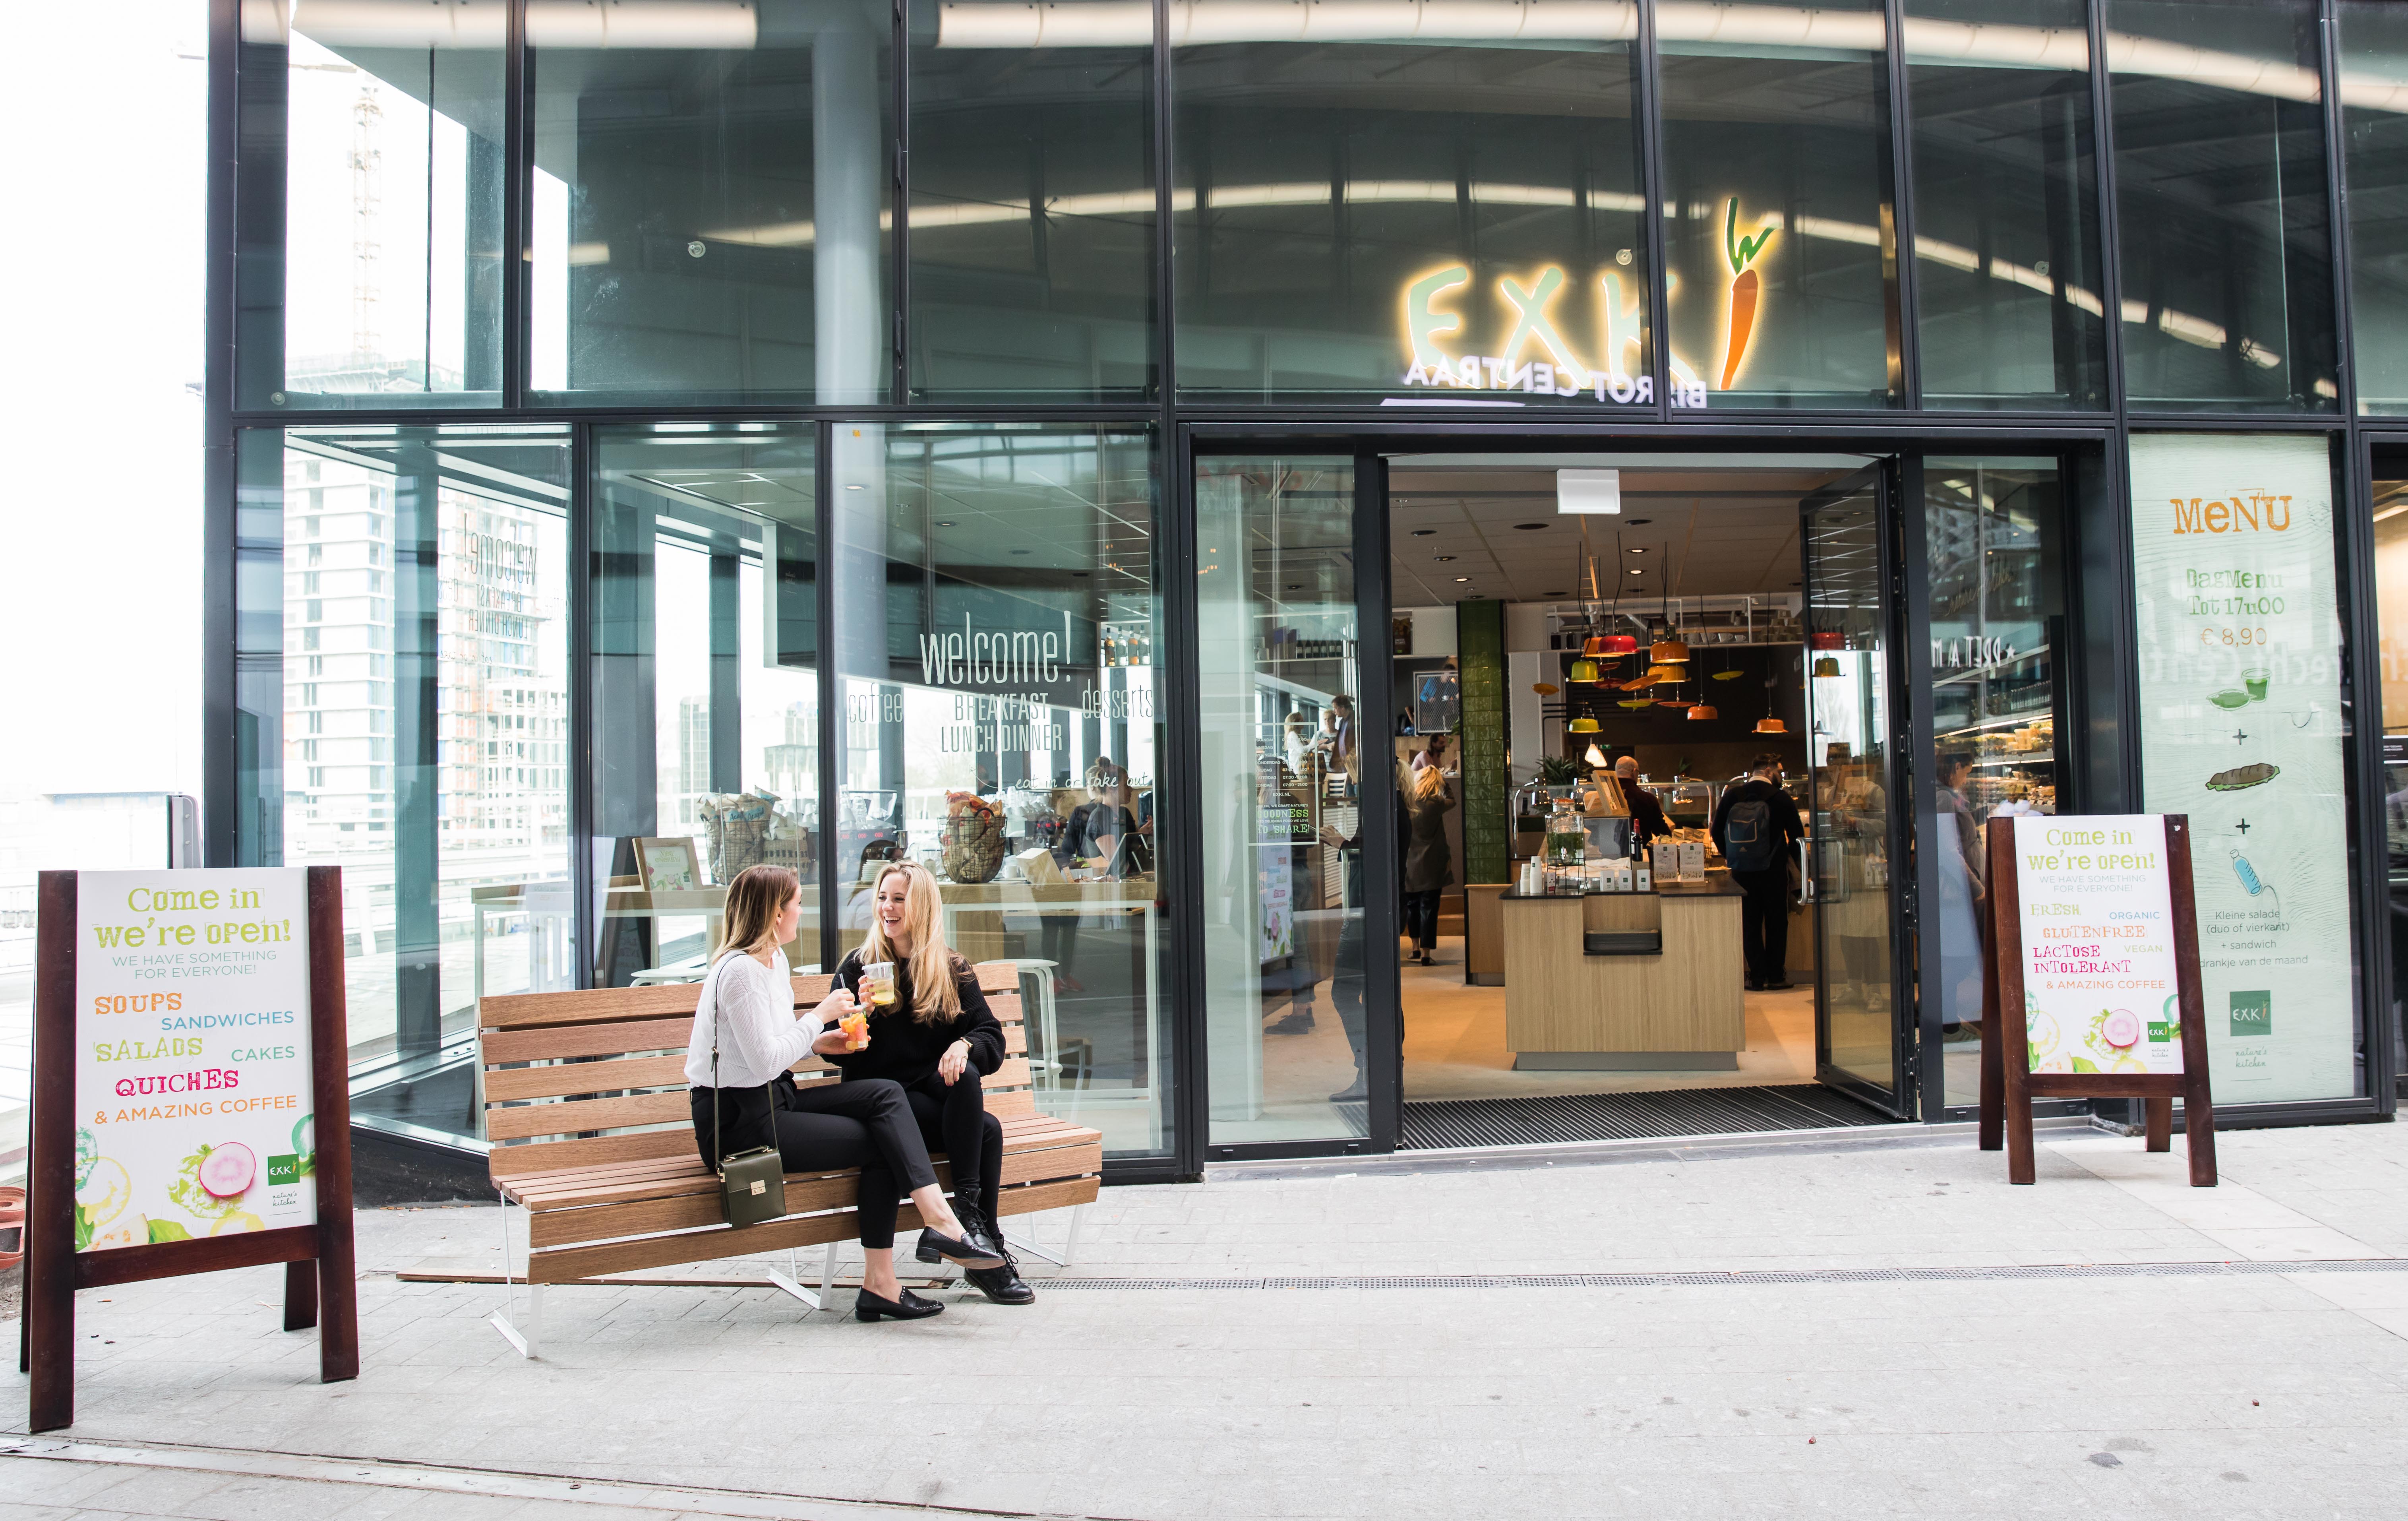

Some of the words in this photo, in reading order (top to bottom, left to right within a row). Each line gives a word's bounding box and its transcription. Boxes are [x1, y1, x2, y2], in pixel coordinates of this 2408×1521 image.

[2189, 595, 2220, 615] Tot
[920, 610, 1071, 684] welcome!
[2222, 628, 2267, 648] 8,90
[849, 683, 903, 723] coffee
[955, 693, 1048, 721] BREAKFAST
[1083, 679, 1153, 719] desserts
[942, 725, 994, 753] LUNCH
[1002, 724, 1063, 752] DINNER
[1015, 778, 1038, 789] eat
[1045, 776, 1058, 788] in
[1065, 778, 1080, 788] or
[1087, 774, 1118, 787] take
[1127, 775, 1148, 787] out
[2047, 829, 2105, 846] Come
[2112, 830, 2133, 844] in
[2027, 850, 2090, 870] we're
[128, 888, 219, 912] Come
[230, 888, 261, 909] in
[2031, 903, 2081, 916] FRESH
[2216, 911, 2245, 919] Kleine
[2249, 910, 2280, 918] salade
[94, 917, 196, 948] we're
[2043, 926, 2145, 938] GLUTENFREE
[2207, 924, 2230, 934] (duo
[2233, 924, 2243, 932] of
[2245, 922, 2290, 932] vierkant)
[2034, 945, 2100, 957] LACTOSE
[2230, 940, 2276, 949] sandwich
[112, 956, 137, 966] WE
[143, 954, 184, 965] HAVE
[190, 950, 277, 963] SOMETHING
[2034, 960, 2131, 973] INTOLERANT
[2200, 958, 2236, 968] drankje
[2259, 956, 2271, 965] de
[2274, 956, 2308, 965] maand
[135, 969, 166, 979] FOR
[172, 965, 256, 977] EVERYONE!
[2118, 980, 2165, 989] COFFEE
[95, 993, 182, 1015] SOUPS
[161, 1011, 294, 1031] SANDWICHES
[96, 1038, 203, 1062] SALADS
[231, 1046, 295, 1062] CAKES
[2236, 1058, 2266, 1068] kitchen
[116, 1069, 239, 1096] QUICHES
[94, 1110, 108, 1124] &
[115, 1102, 213, 1122] AMAZING
[220, 1096, 297, 1113] COFFEE
